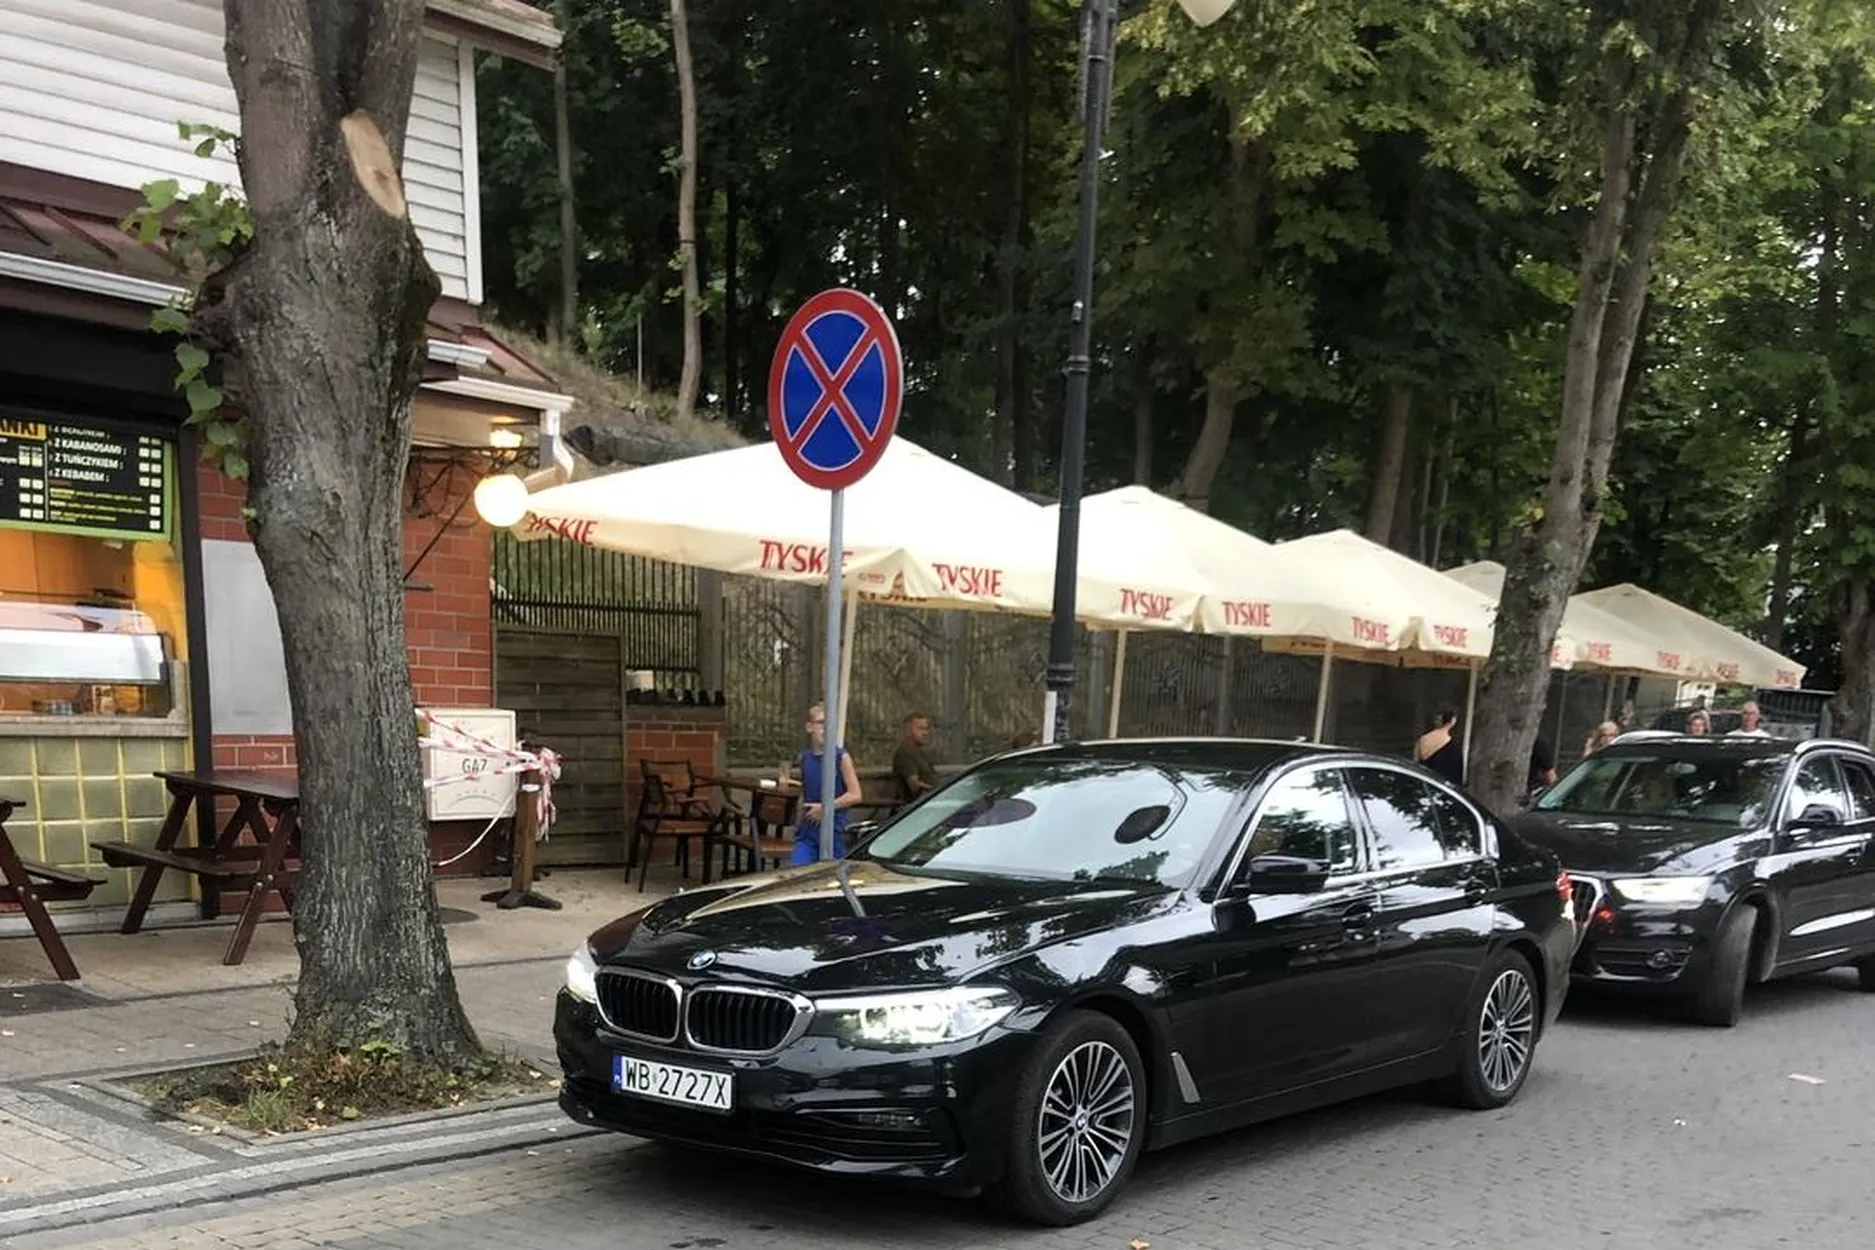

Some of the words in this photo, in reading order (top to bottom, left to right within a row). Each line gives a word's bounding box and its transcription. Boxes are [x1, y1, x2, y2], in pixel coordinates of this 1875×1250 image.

[759, 539, 853, 578] TYSKE
[931, 562, 1003, 597] TYSKIE
[1120, 588, 1174, 621] TYSKIE
[1222, 601, 1271, 627] TYSKIE
[626, 1060, 650, 1090] WB
[659, 1067, 726, 1106] 2727X
